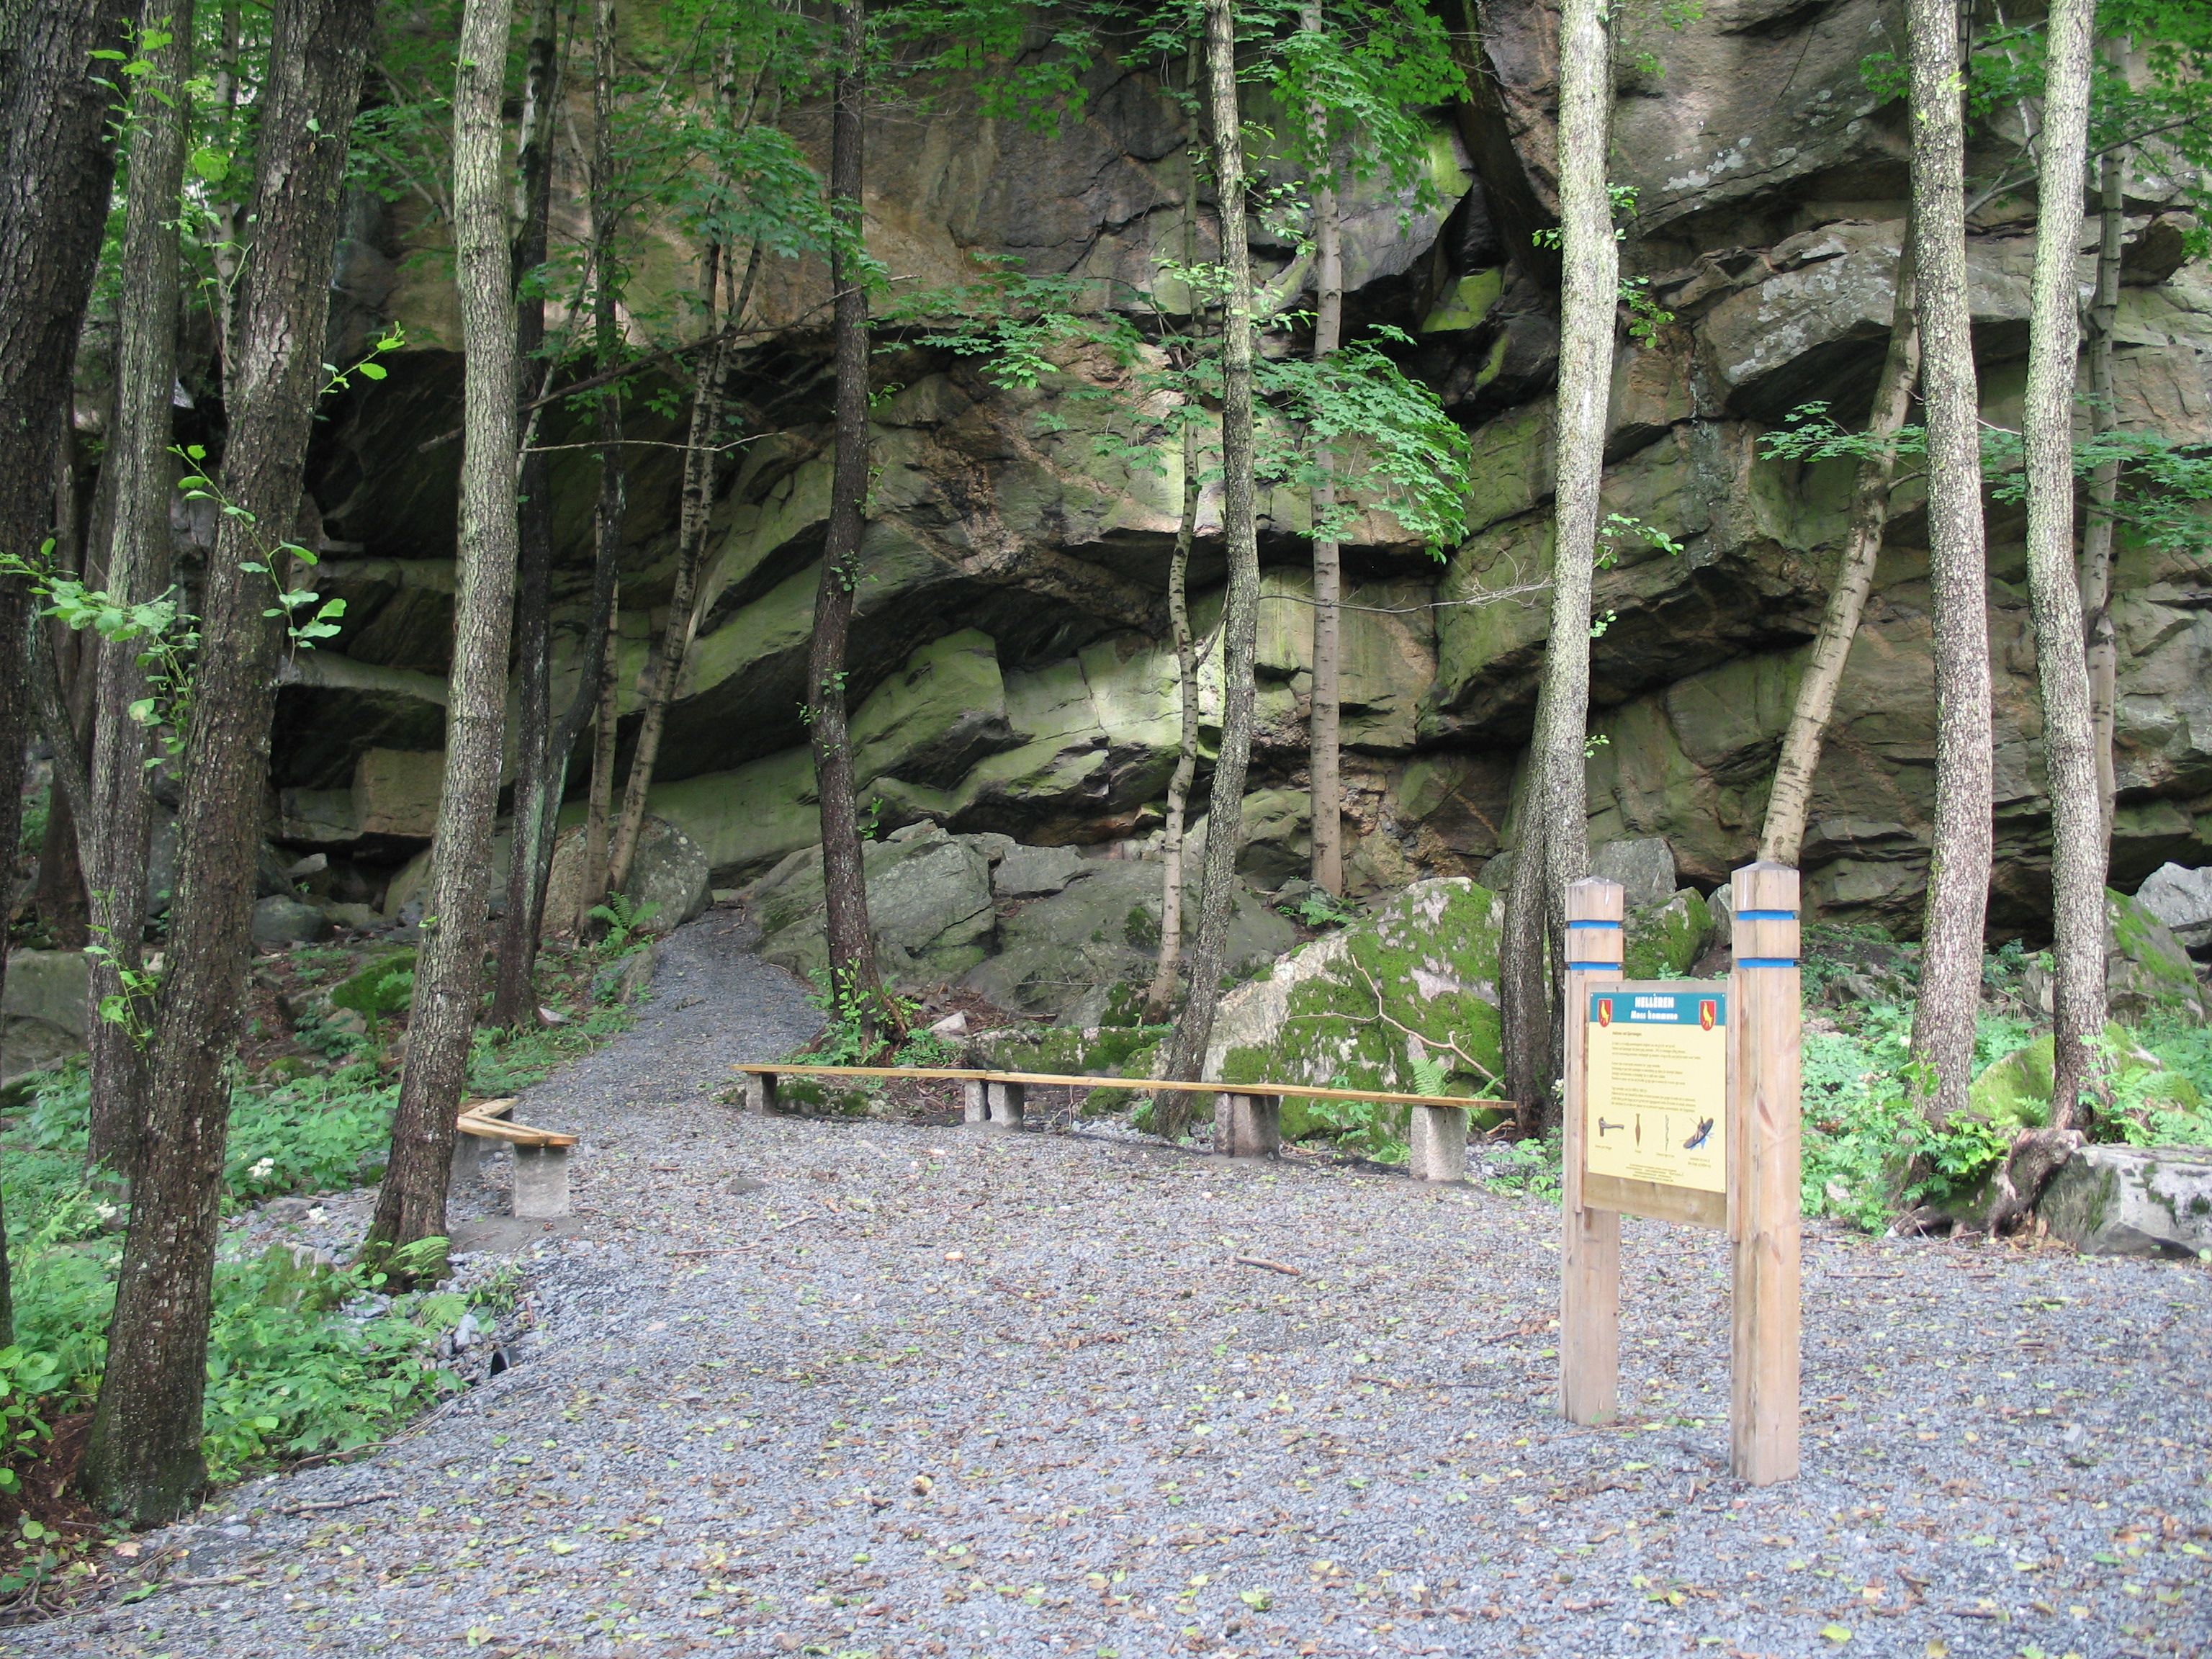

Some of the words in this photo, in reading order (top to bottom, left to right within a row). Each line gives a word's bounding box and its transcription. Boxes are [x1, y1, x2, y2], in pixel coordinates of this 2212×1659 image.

[1635, 996, 1674, 1009] HELLEREN
[1630, 1010, 1646, 1020] Moss
[1647, 1010, 1678, 1020] kommune
